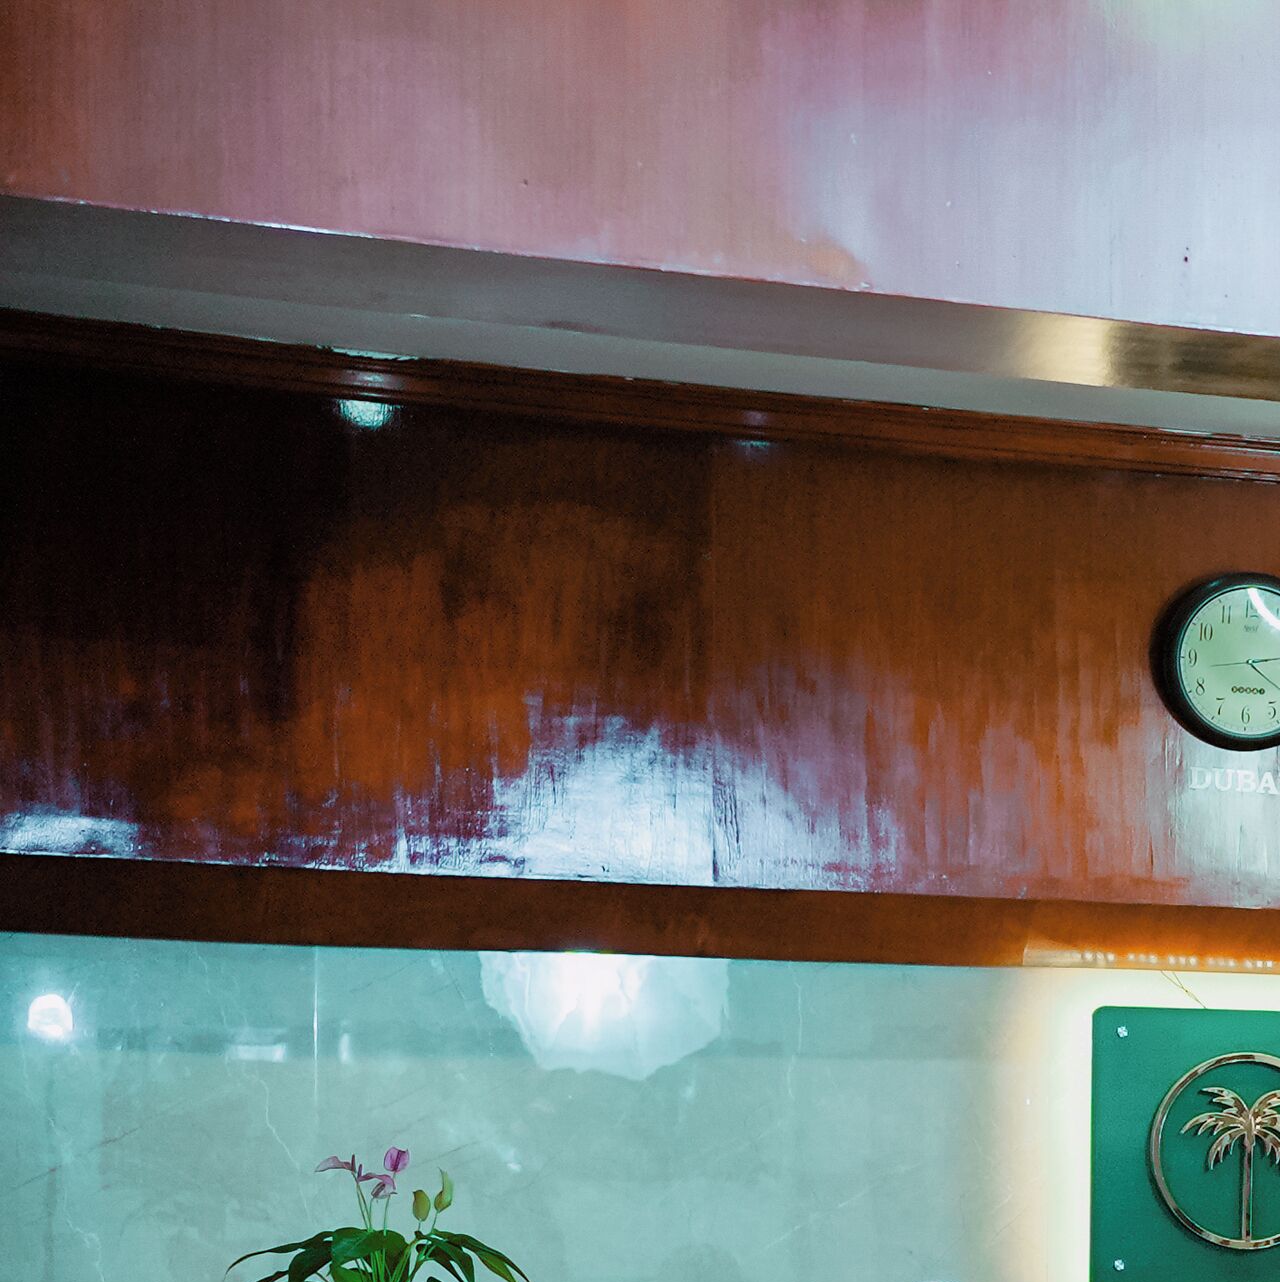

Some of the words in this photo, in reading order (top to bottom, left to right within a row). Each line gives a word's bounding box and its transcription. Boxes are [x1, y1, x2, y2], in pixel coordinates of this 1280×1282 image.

[1220, 604, 1232, 624] 11
[1198, 622, 1213, 641] 10
[1187, 648, 1198, 666] 9
[1195, 676, 1206, 696] 8
[1216, 697, 1225, 716] 7
[1240, 707, 1250, 724] 6
[1267, 701, 1278, 719] 5
